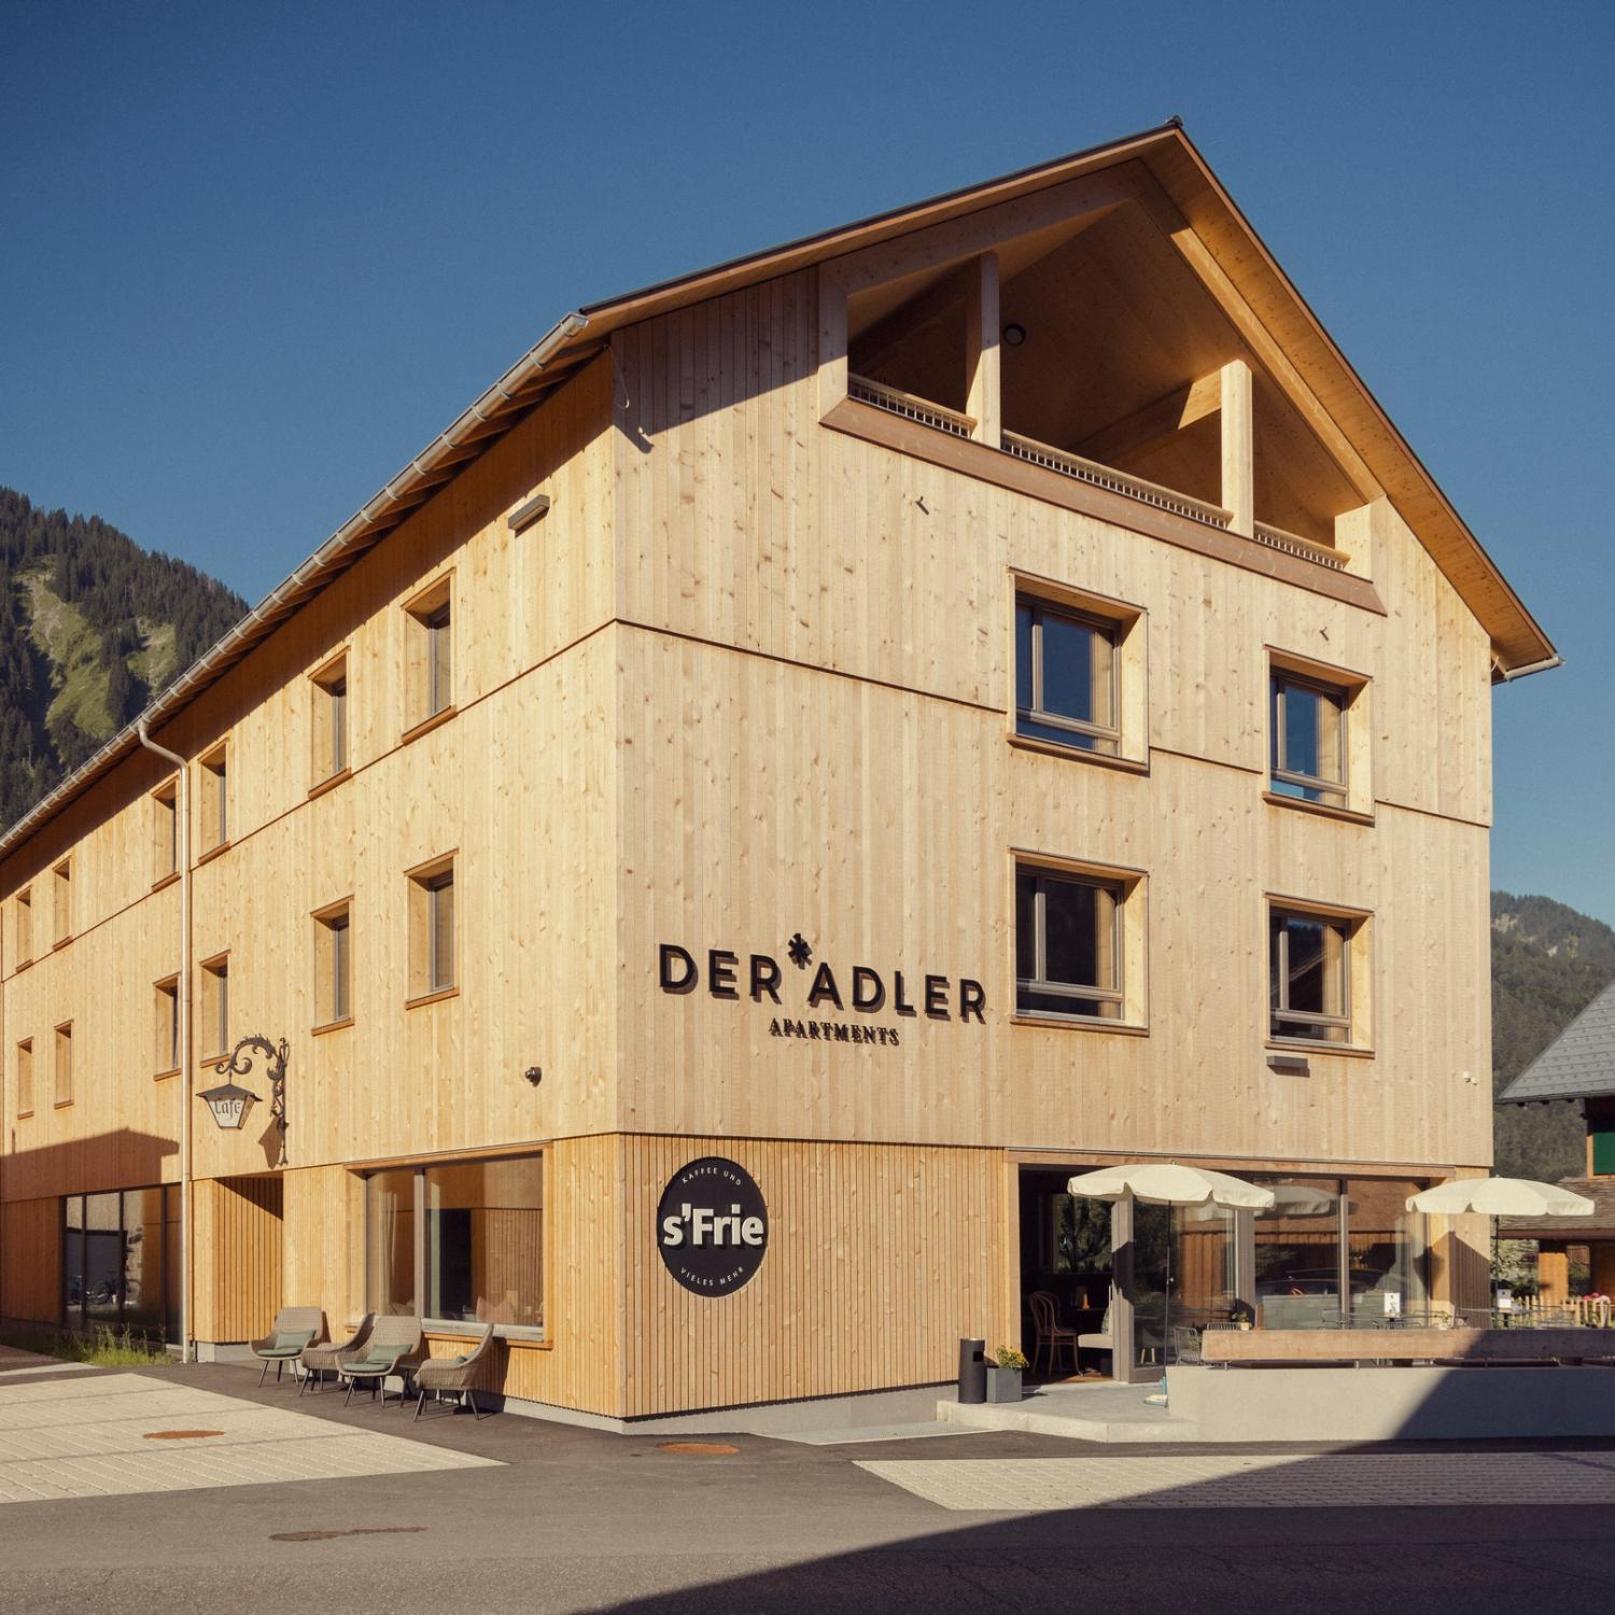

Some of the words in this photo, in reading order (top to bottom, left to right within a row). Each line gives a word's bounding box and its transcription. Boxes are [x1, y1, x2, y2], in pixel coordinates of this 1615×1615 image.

[659, 944, 781, 1004] DER
[807, 961, 986, 1025] ADLER
[768, 1018, 900, 1046] APARTMENTS
[682, 1167, 718, 1184] KAFFEE
[723, 1170, 742, 1186] UND
[681, 1267, 714, 1286] VIELES
